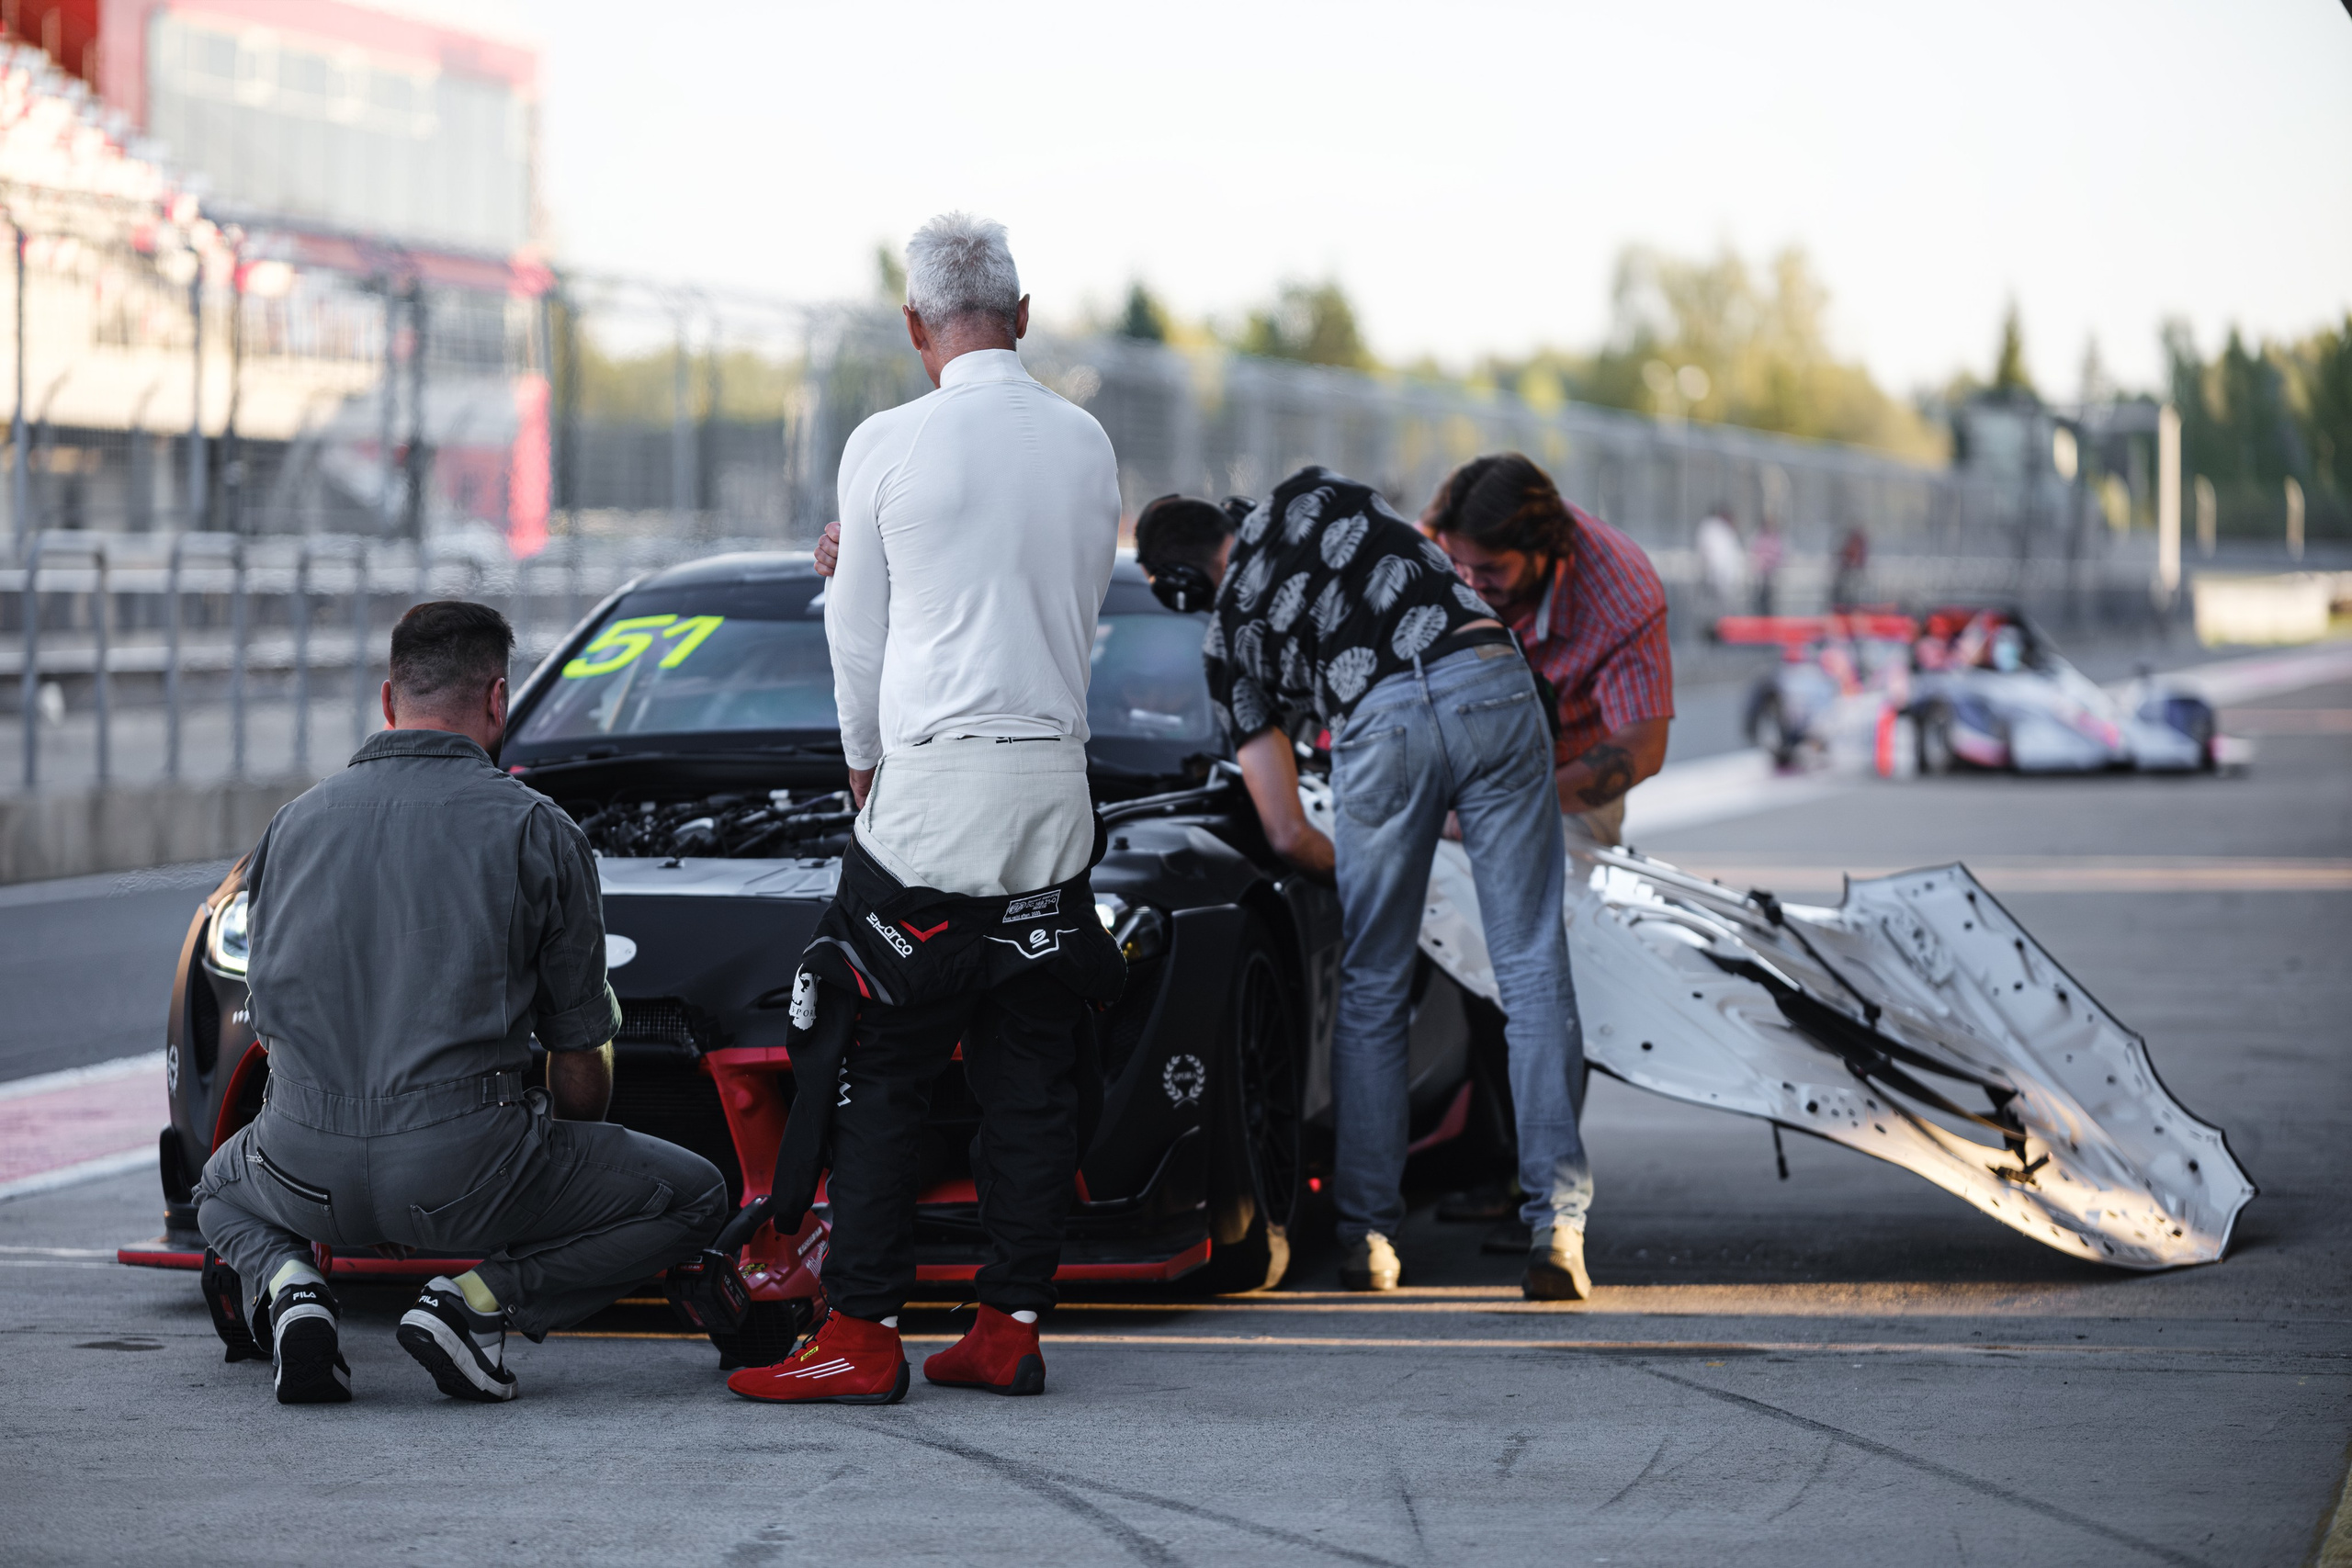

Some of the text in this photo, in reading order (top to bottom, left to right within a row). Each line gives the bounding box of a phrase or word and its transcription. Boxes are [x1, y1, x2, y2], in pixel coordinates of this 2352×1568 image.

[561, 614, 725, 679] 51
[292, 1291, 317, 1301] FILA
[419, 1295, 439, 1307] FILA
